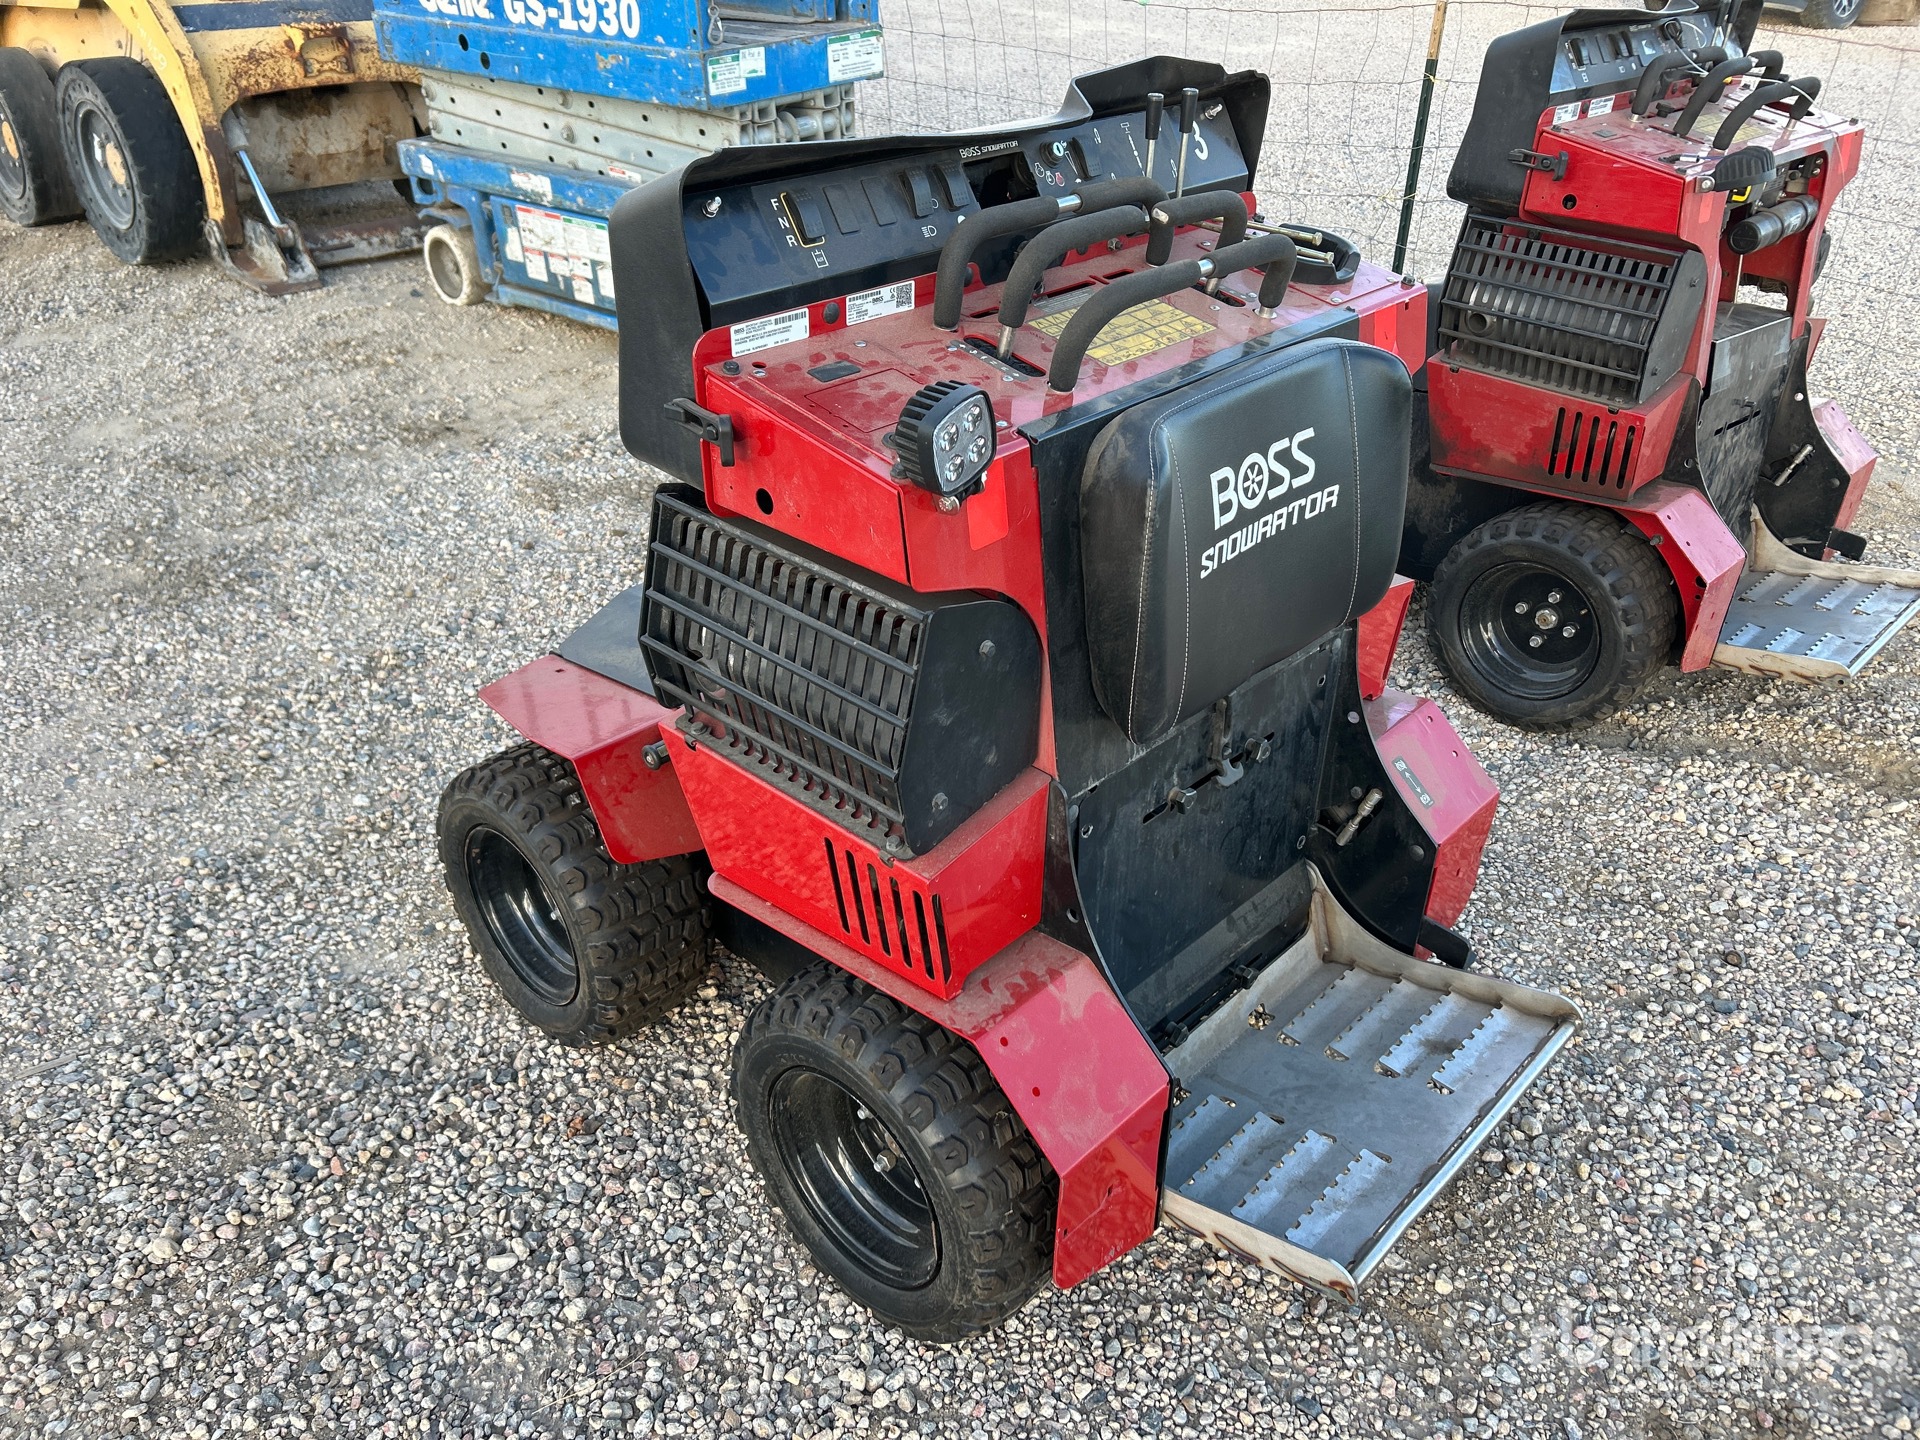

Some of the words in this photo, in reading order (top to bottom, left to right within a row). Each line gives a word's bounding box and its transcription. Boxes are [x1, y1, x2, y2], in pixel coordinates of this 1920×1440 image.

[503, 0, 641, 38] GS-1930
[959, 145, 981, 159] BOSS
[981, 140, 1019, 153] SNOWRATOR
[770, 198, 780, 211] F
[777, 216, 790, 229] N
[785, 234, 798, 247] R
[1209, 426, 1316, 531] BOSS
[1200, 483, 1341, 580] SNOWRATOR
